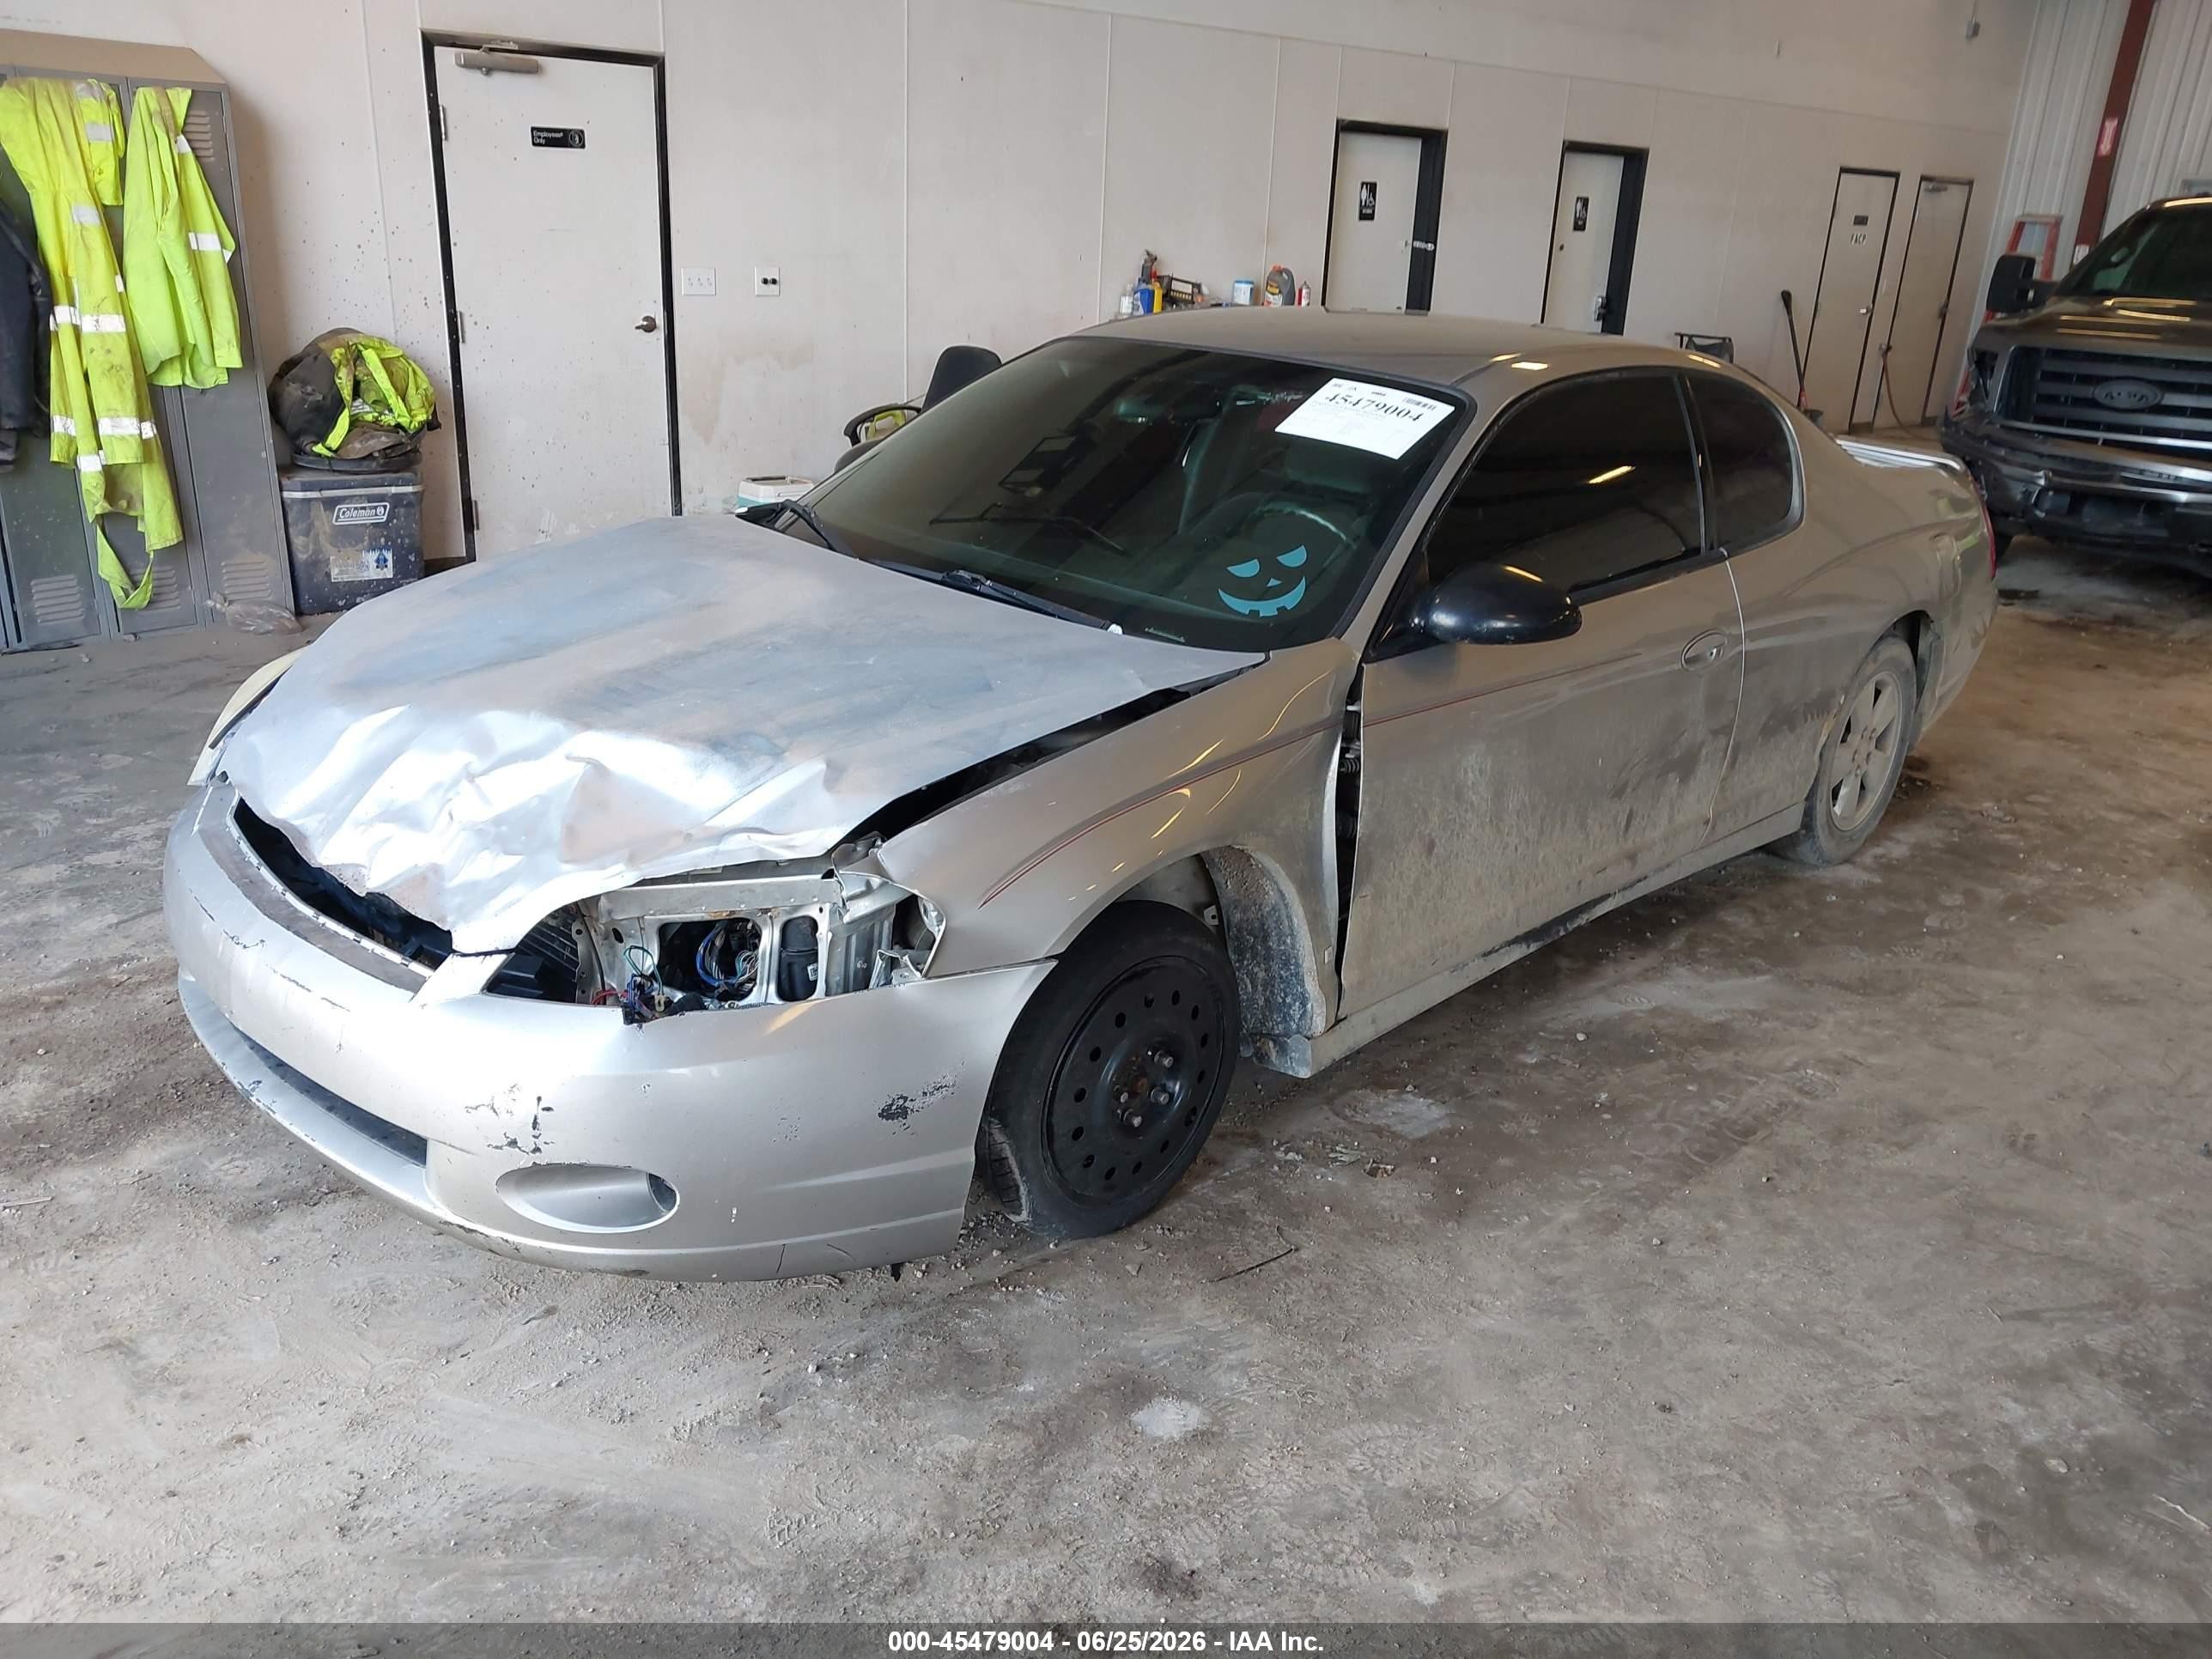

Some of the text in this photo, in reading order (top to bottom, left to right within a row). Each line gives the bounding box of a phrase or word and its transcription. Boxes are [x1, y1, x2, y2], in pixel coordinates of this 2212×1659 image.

[533, 137, 546, 145] Only
[1325, 393, 1425, 422] 45479004
[339, 507, 377, 519] Coleman
